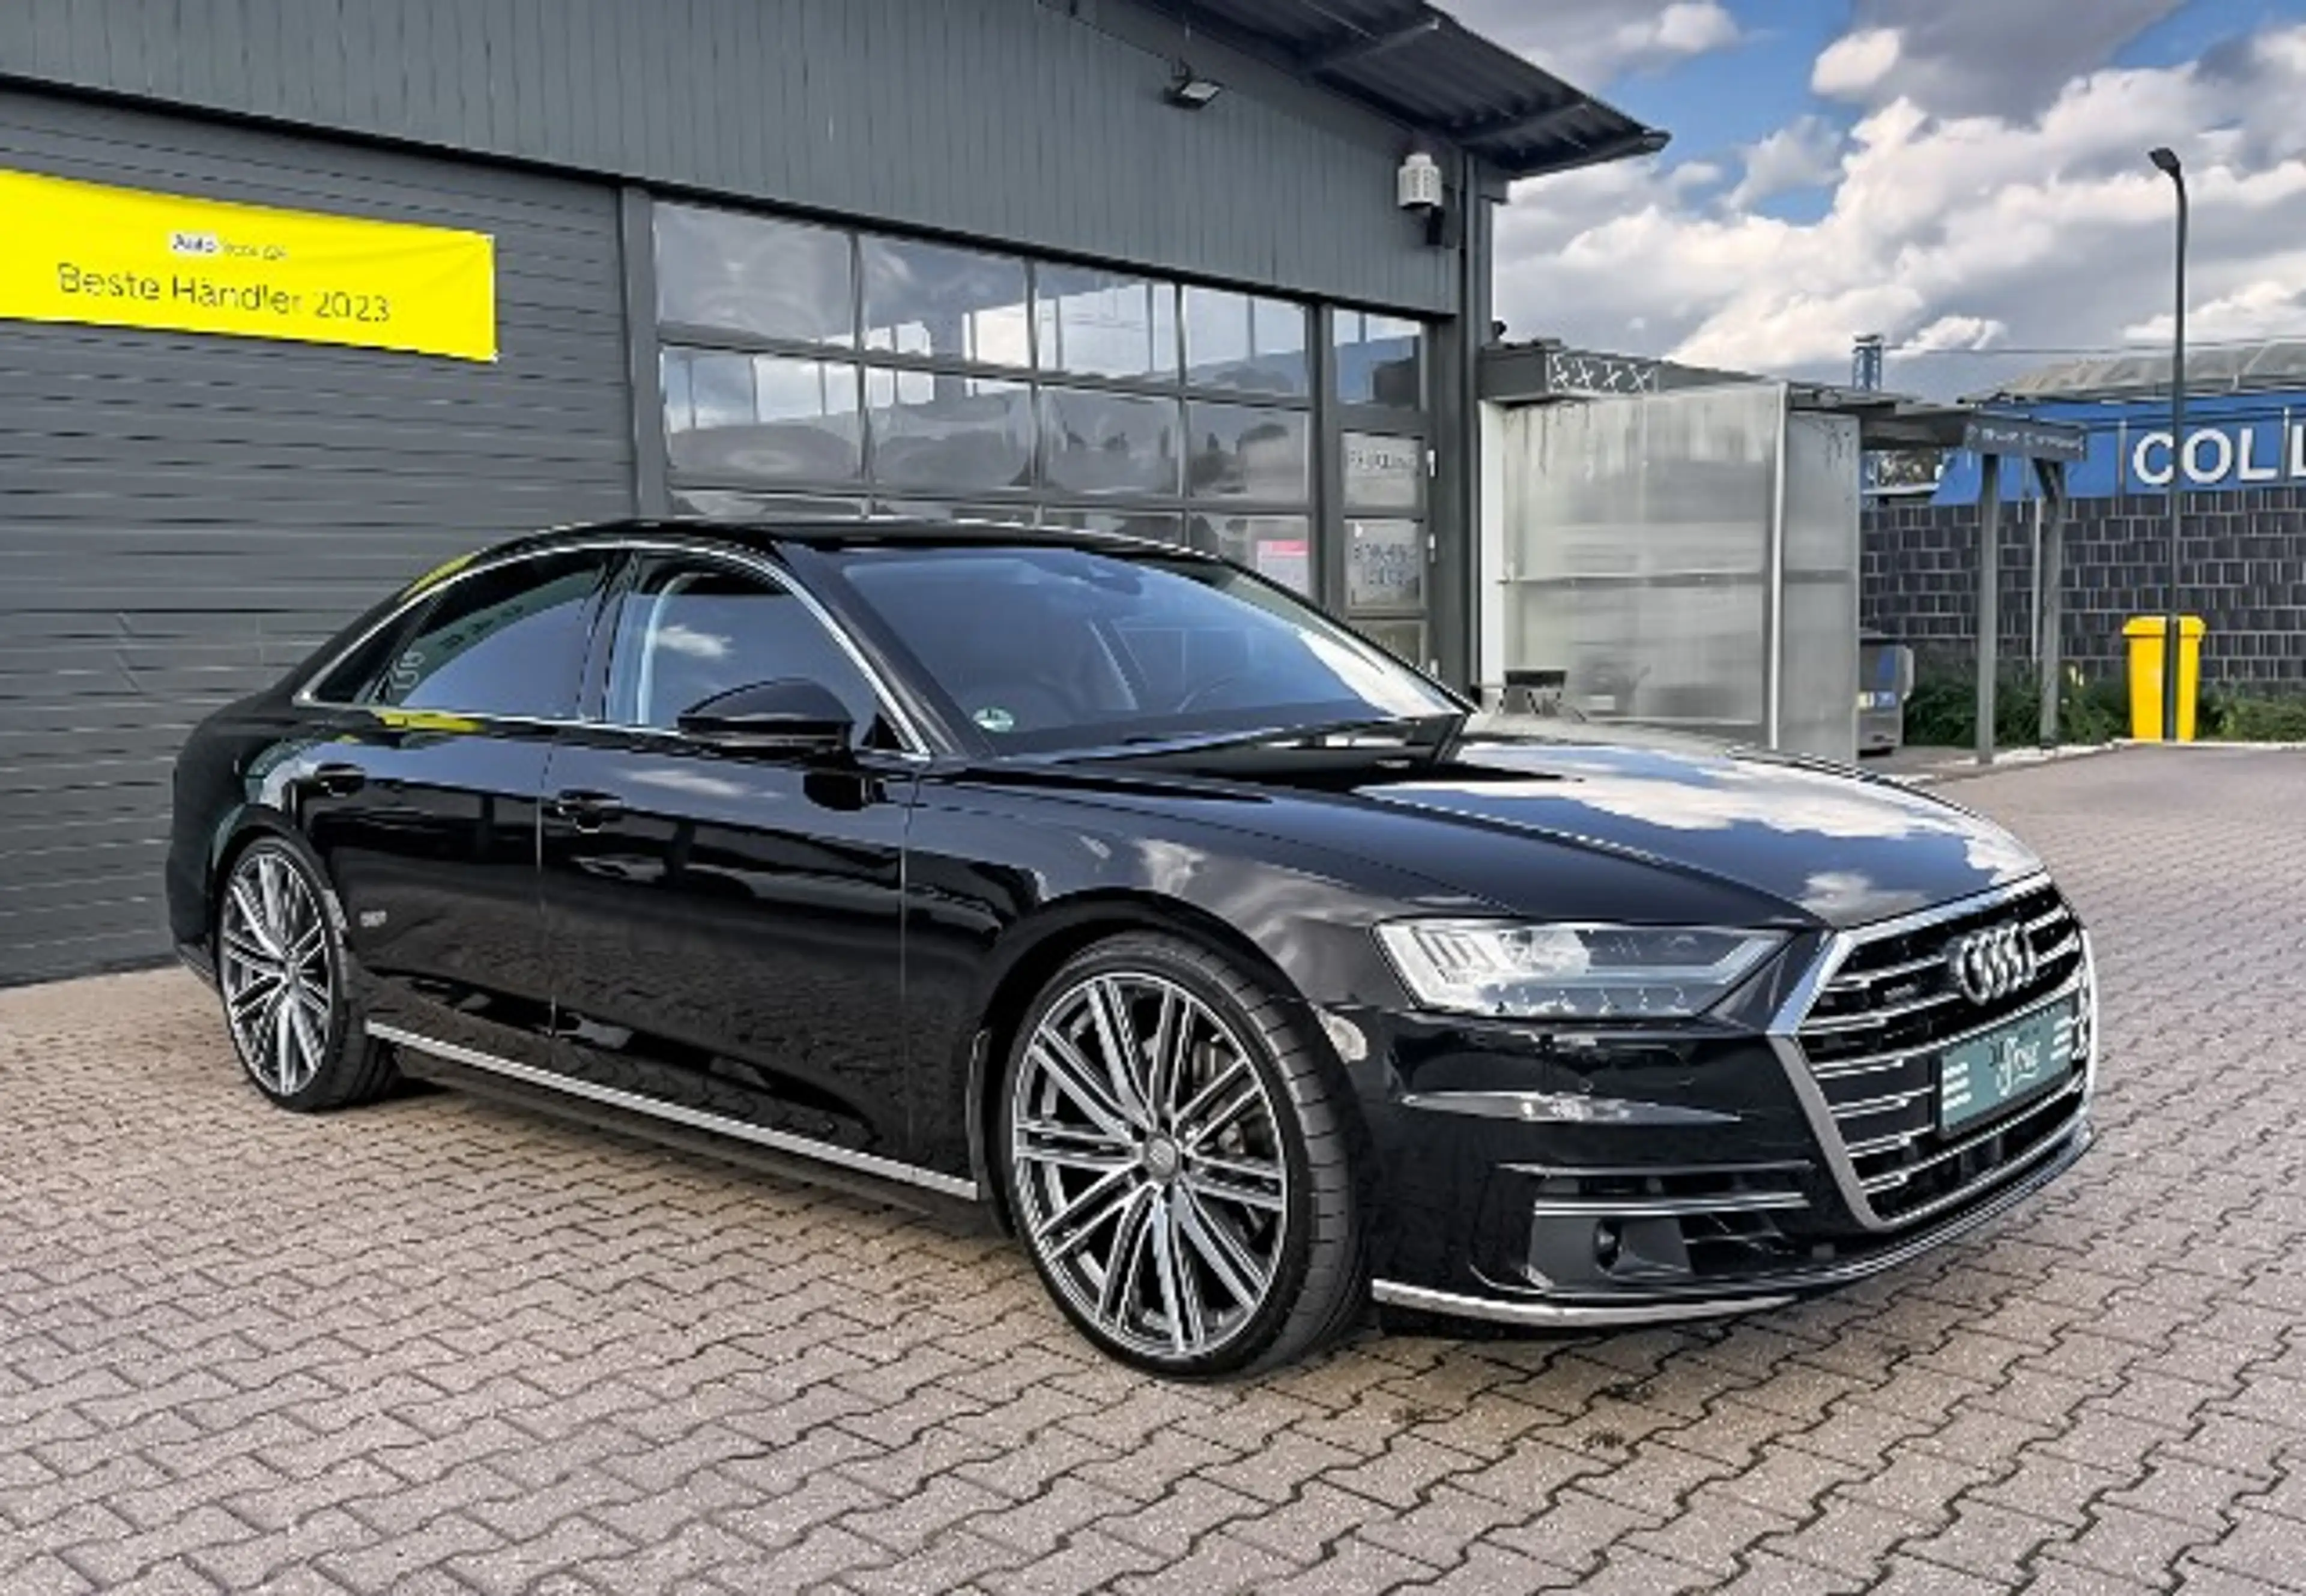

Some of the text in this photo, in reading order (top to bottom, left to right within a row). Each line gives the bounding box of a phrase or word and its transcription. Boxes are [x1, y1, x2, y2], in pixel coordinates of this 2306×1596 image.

[57, 262, 390, 322] Beste Händler 2023
